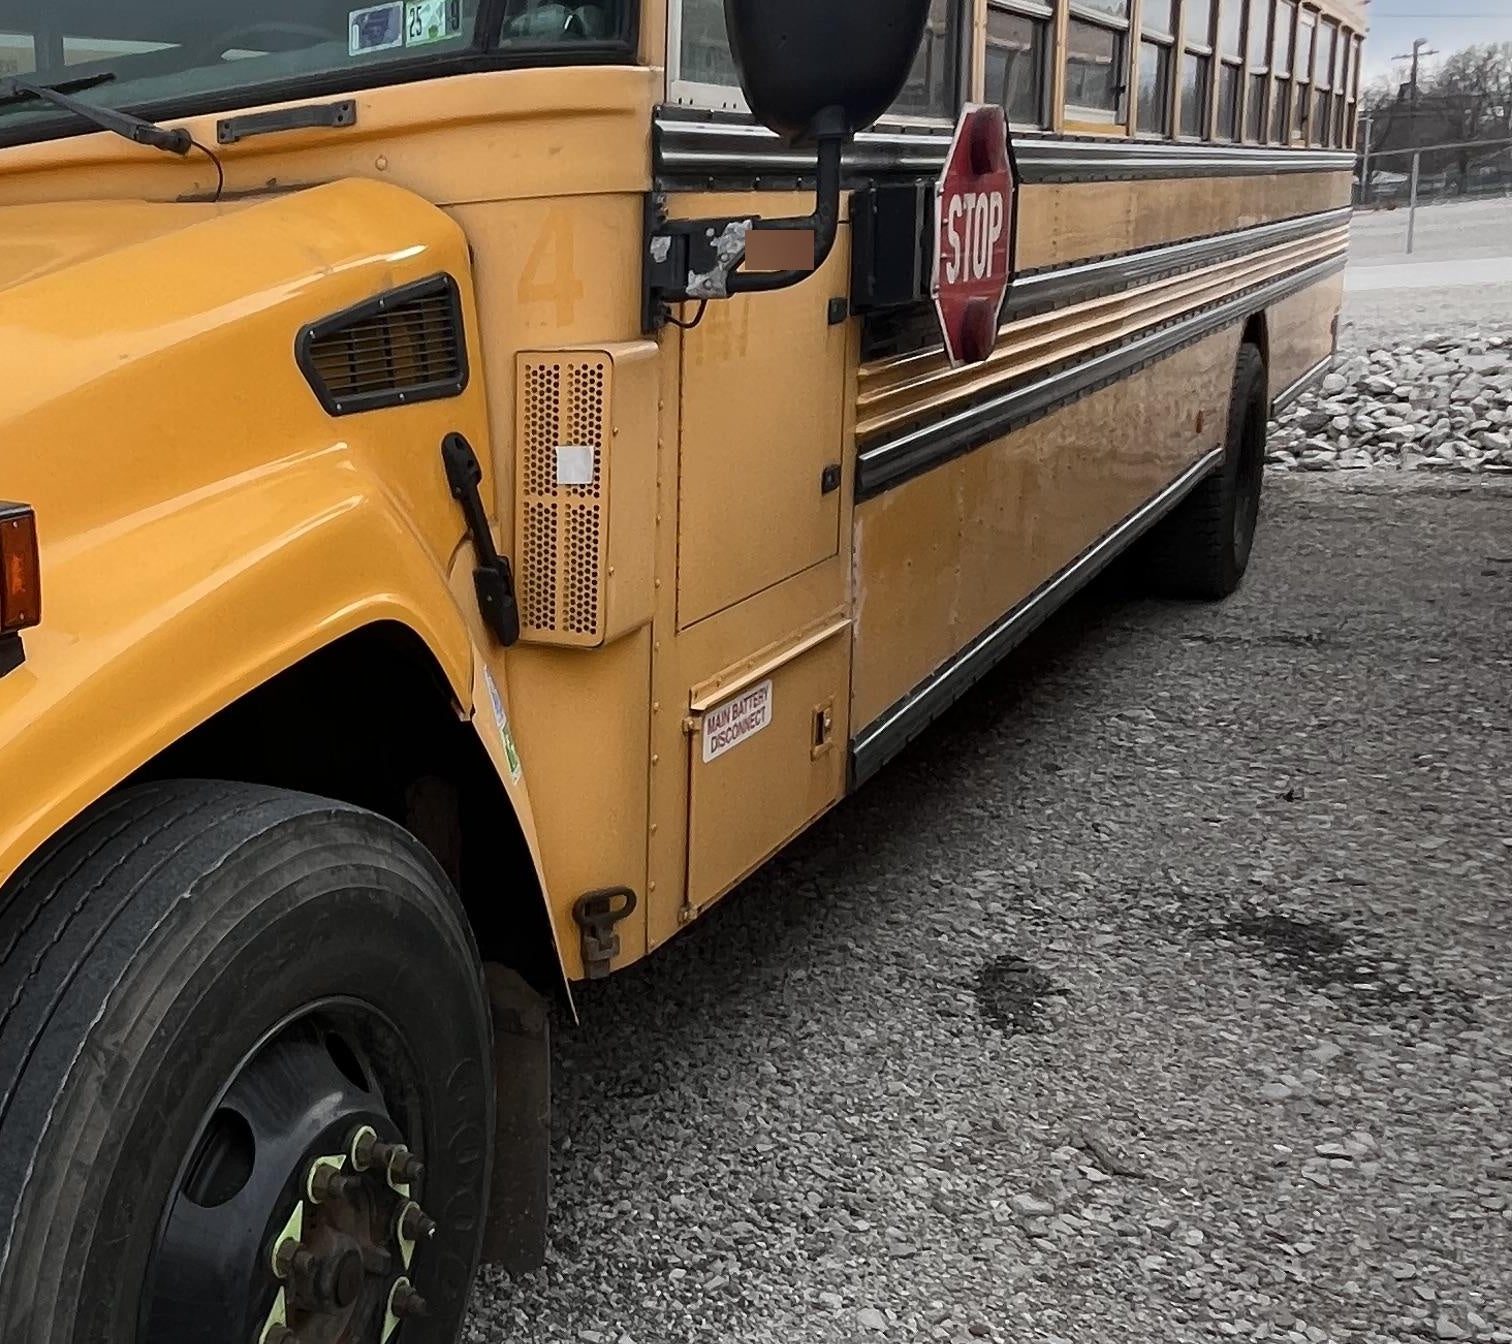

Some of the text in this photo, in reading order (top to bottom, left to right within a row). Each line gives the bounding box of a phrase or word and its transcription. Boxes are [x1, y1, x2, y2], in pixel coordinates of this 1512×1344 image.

[409, 5, 423, 38] 25
[945, 191, 1003, 284] STOP
[517, 209, 584, 328] 4
[707, 685, 768, 735] MAIN BATTERY
[710, 706, 766, 754] DISCONNECT
